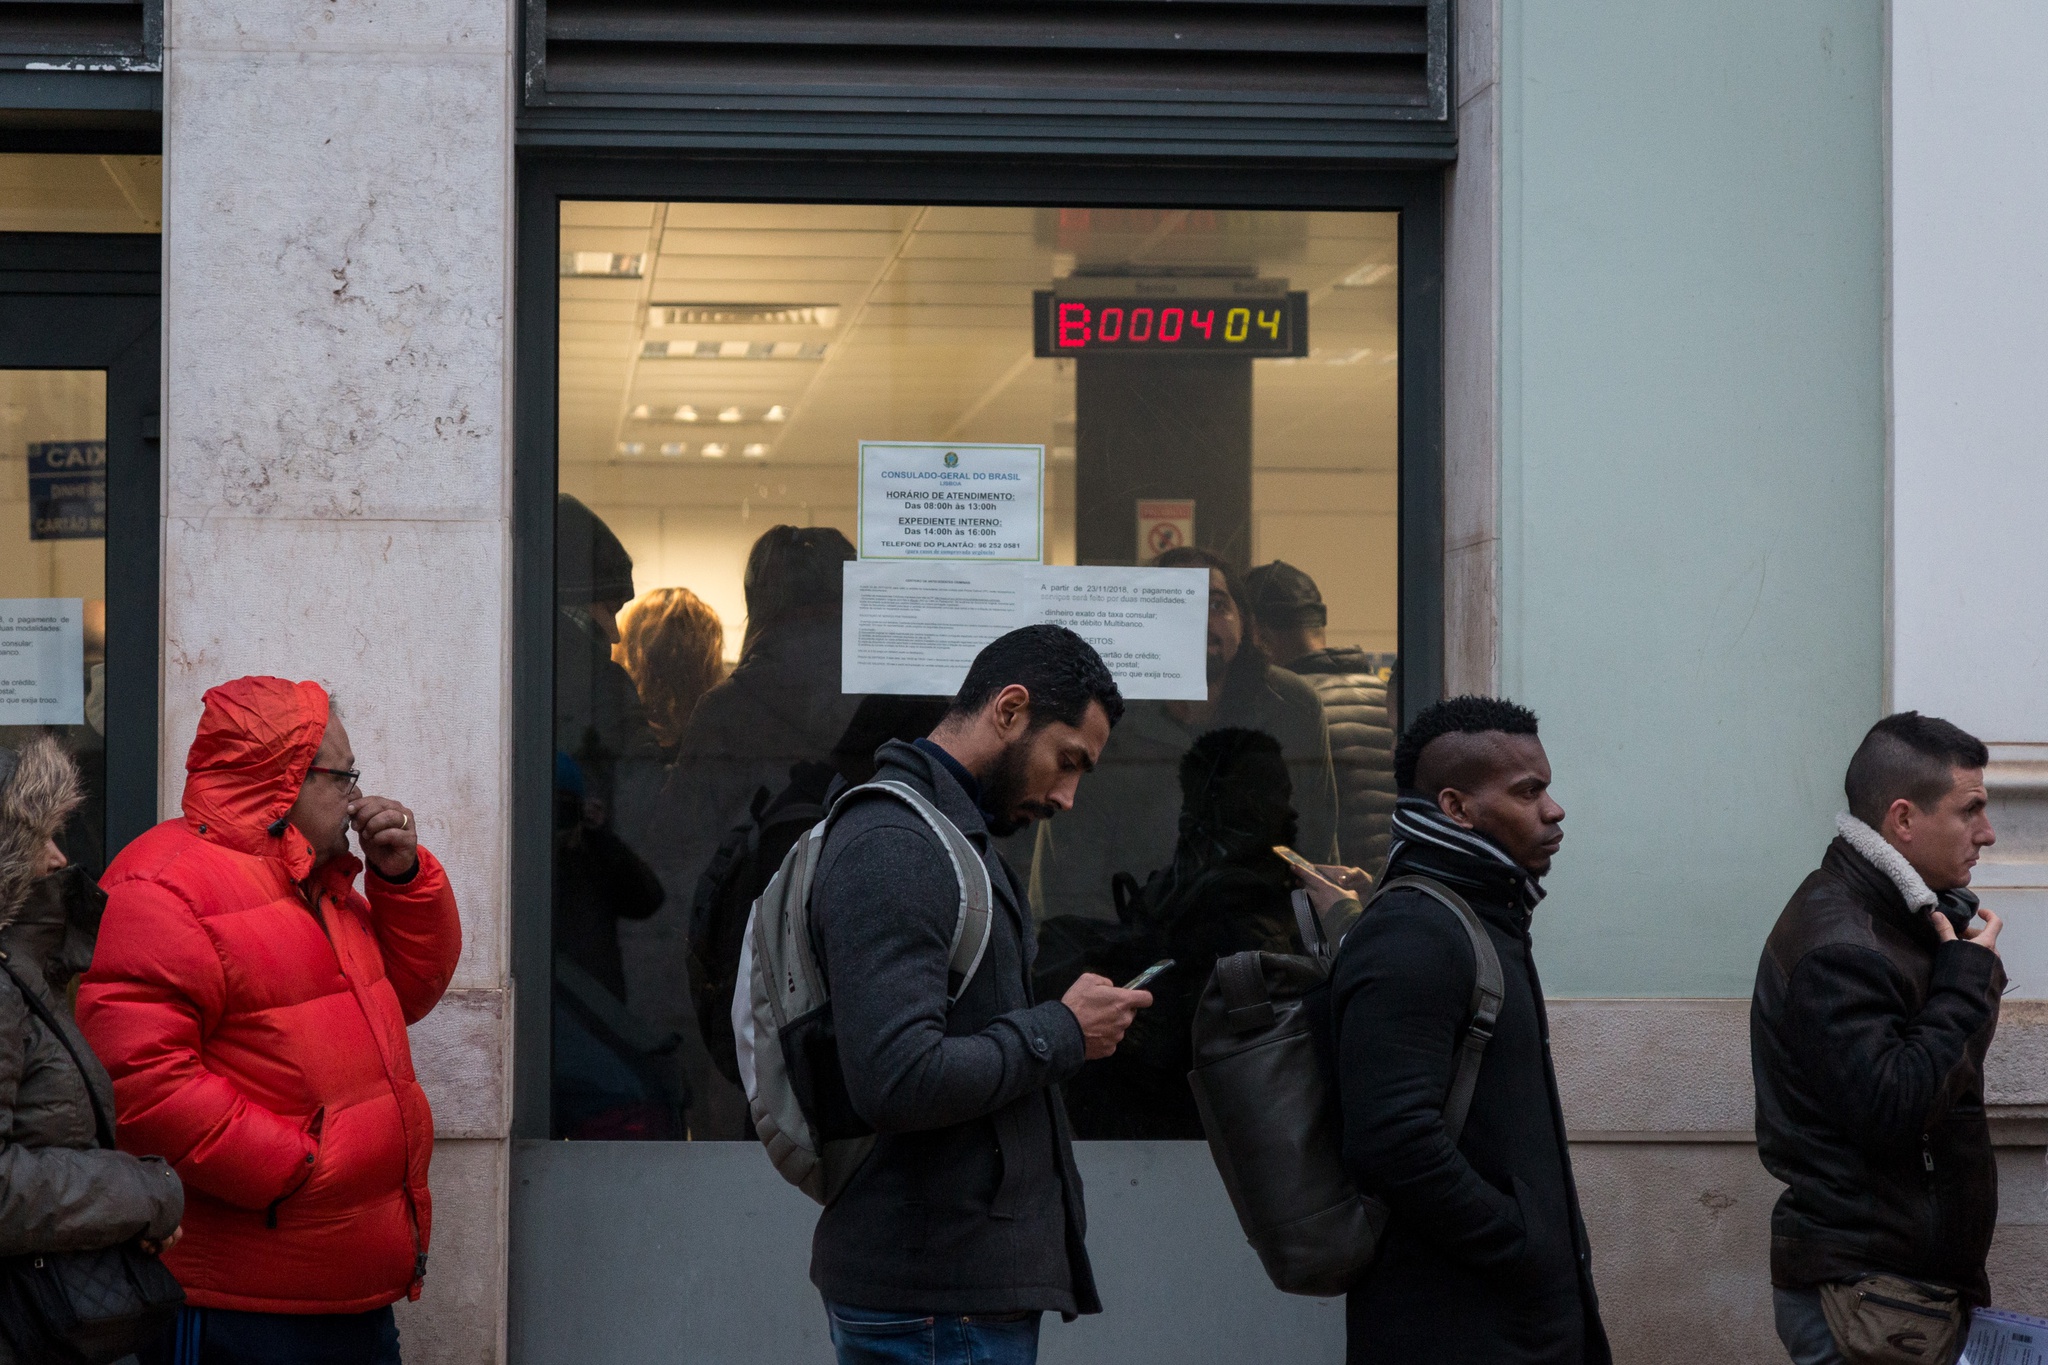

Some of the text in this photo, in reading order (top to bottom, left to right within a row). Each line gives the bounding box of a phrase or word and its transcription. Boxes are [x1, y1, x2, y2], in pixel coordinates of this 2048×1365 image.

[1224, 307, 1281, 342] 04
[881, 471, 1021, 481] CONSULADO-GERAL DO BRASIL
[886, 490, 1015, 501] HORÁRIO DE ATENDIMENTO:
[905, 502, 997, 511] Das 08:00h às 13:00h
[898, 517, 1002, 527] EXPEDIENTE INTERNO:
[924, 528, 952, 536] 14:00h
[954, 528, 965, 536] às
[968, 528, 996, 536] 16:00h
[17, 616, 57, 624] pagamento
[1125, 612, 1158, 620] consular;
